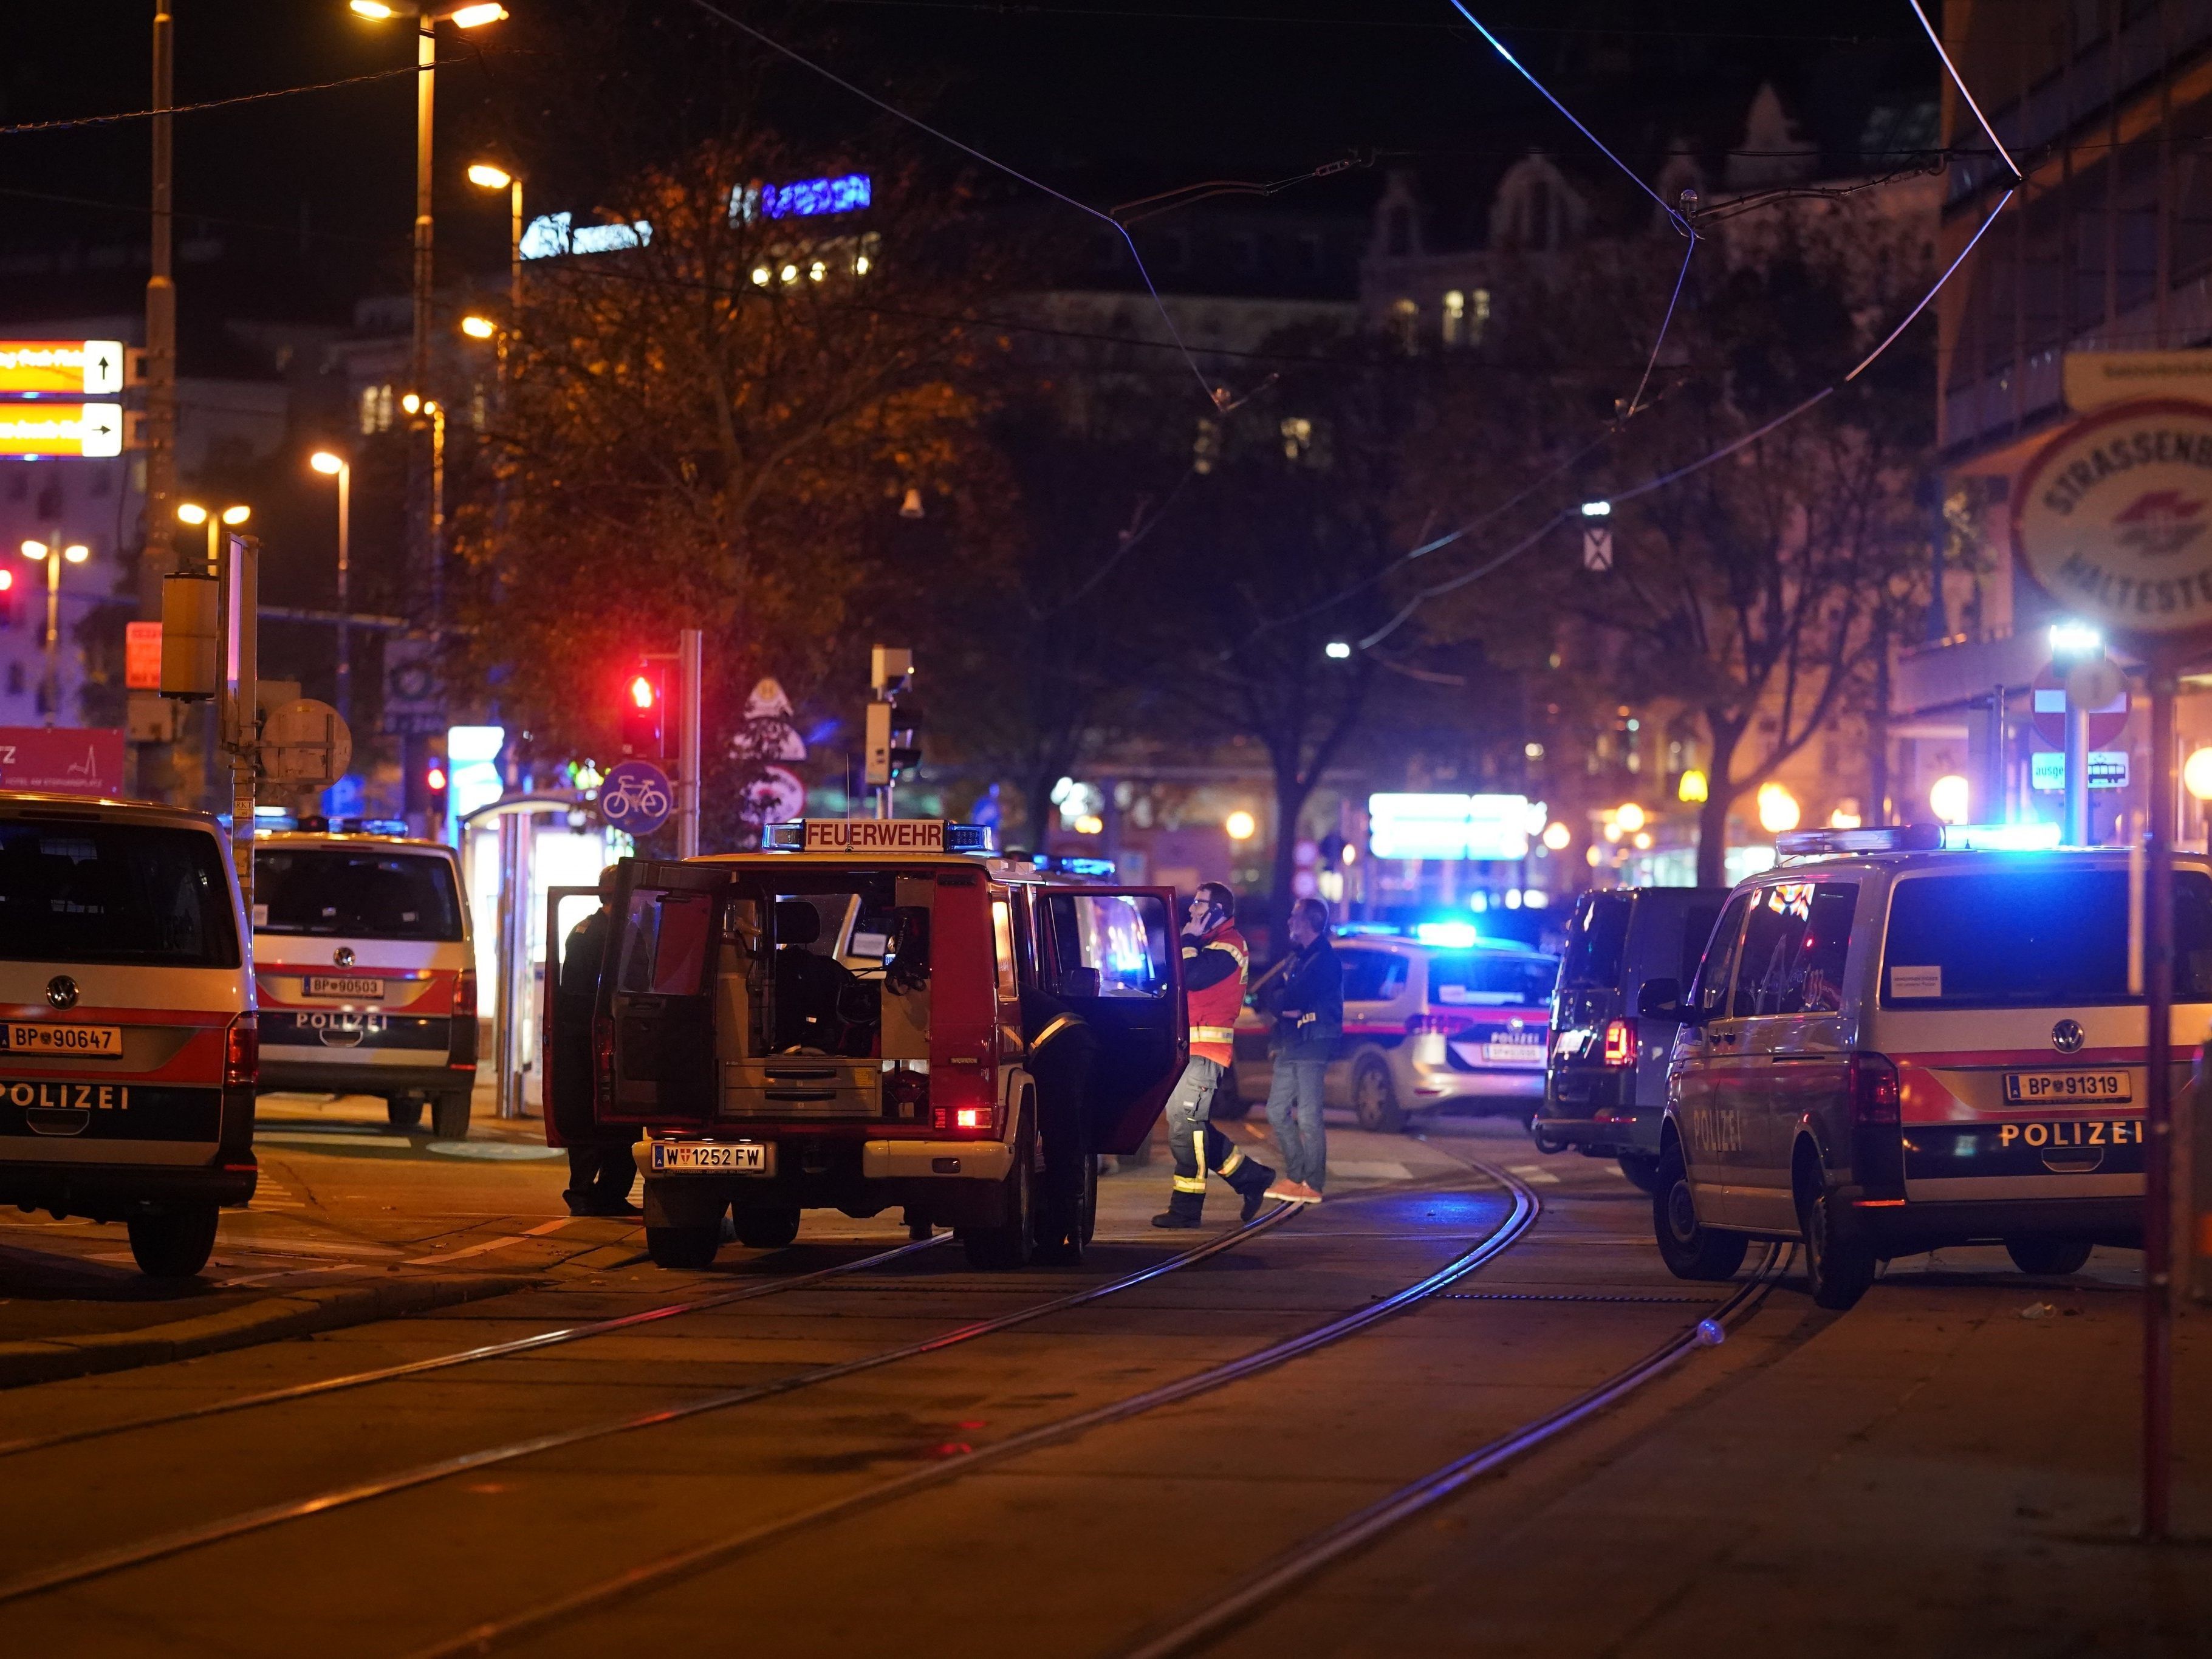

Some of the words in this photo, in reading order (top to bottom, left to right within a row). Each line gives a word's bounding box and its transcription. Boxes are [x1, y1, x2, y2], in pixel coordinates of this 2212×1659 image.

[807, 824, 941, 846] FEUERWEHR
[296, 1013, 388, 1031] POLIZEI
[16, 1028, 38, 1047] BP
[54, 1029, 112, 1049] 90647
[2029, 1078, 2051, 1095] BP
[2066, 1076, 2118, 1094] 91319
[1693, 1109, 1742, 1152] POLIZEI
[2001, 1121, 2143, 1147] POLIZEI
[667, 1149, 679, 1165] W
[692, 1149, 731, 1165] 1252
[736, 1149, 759, 1166] FW
